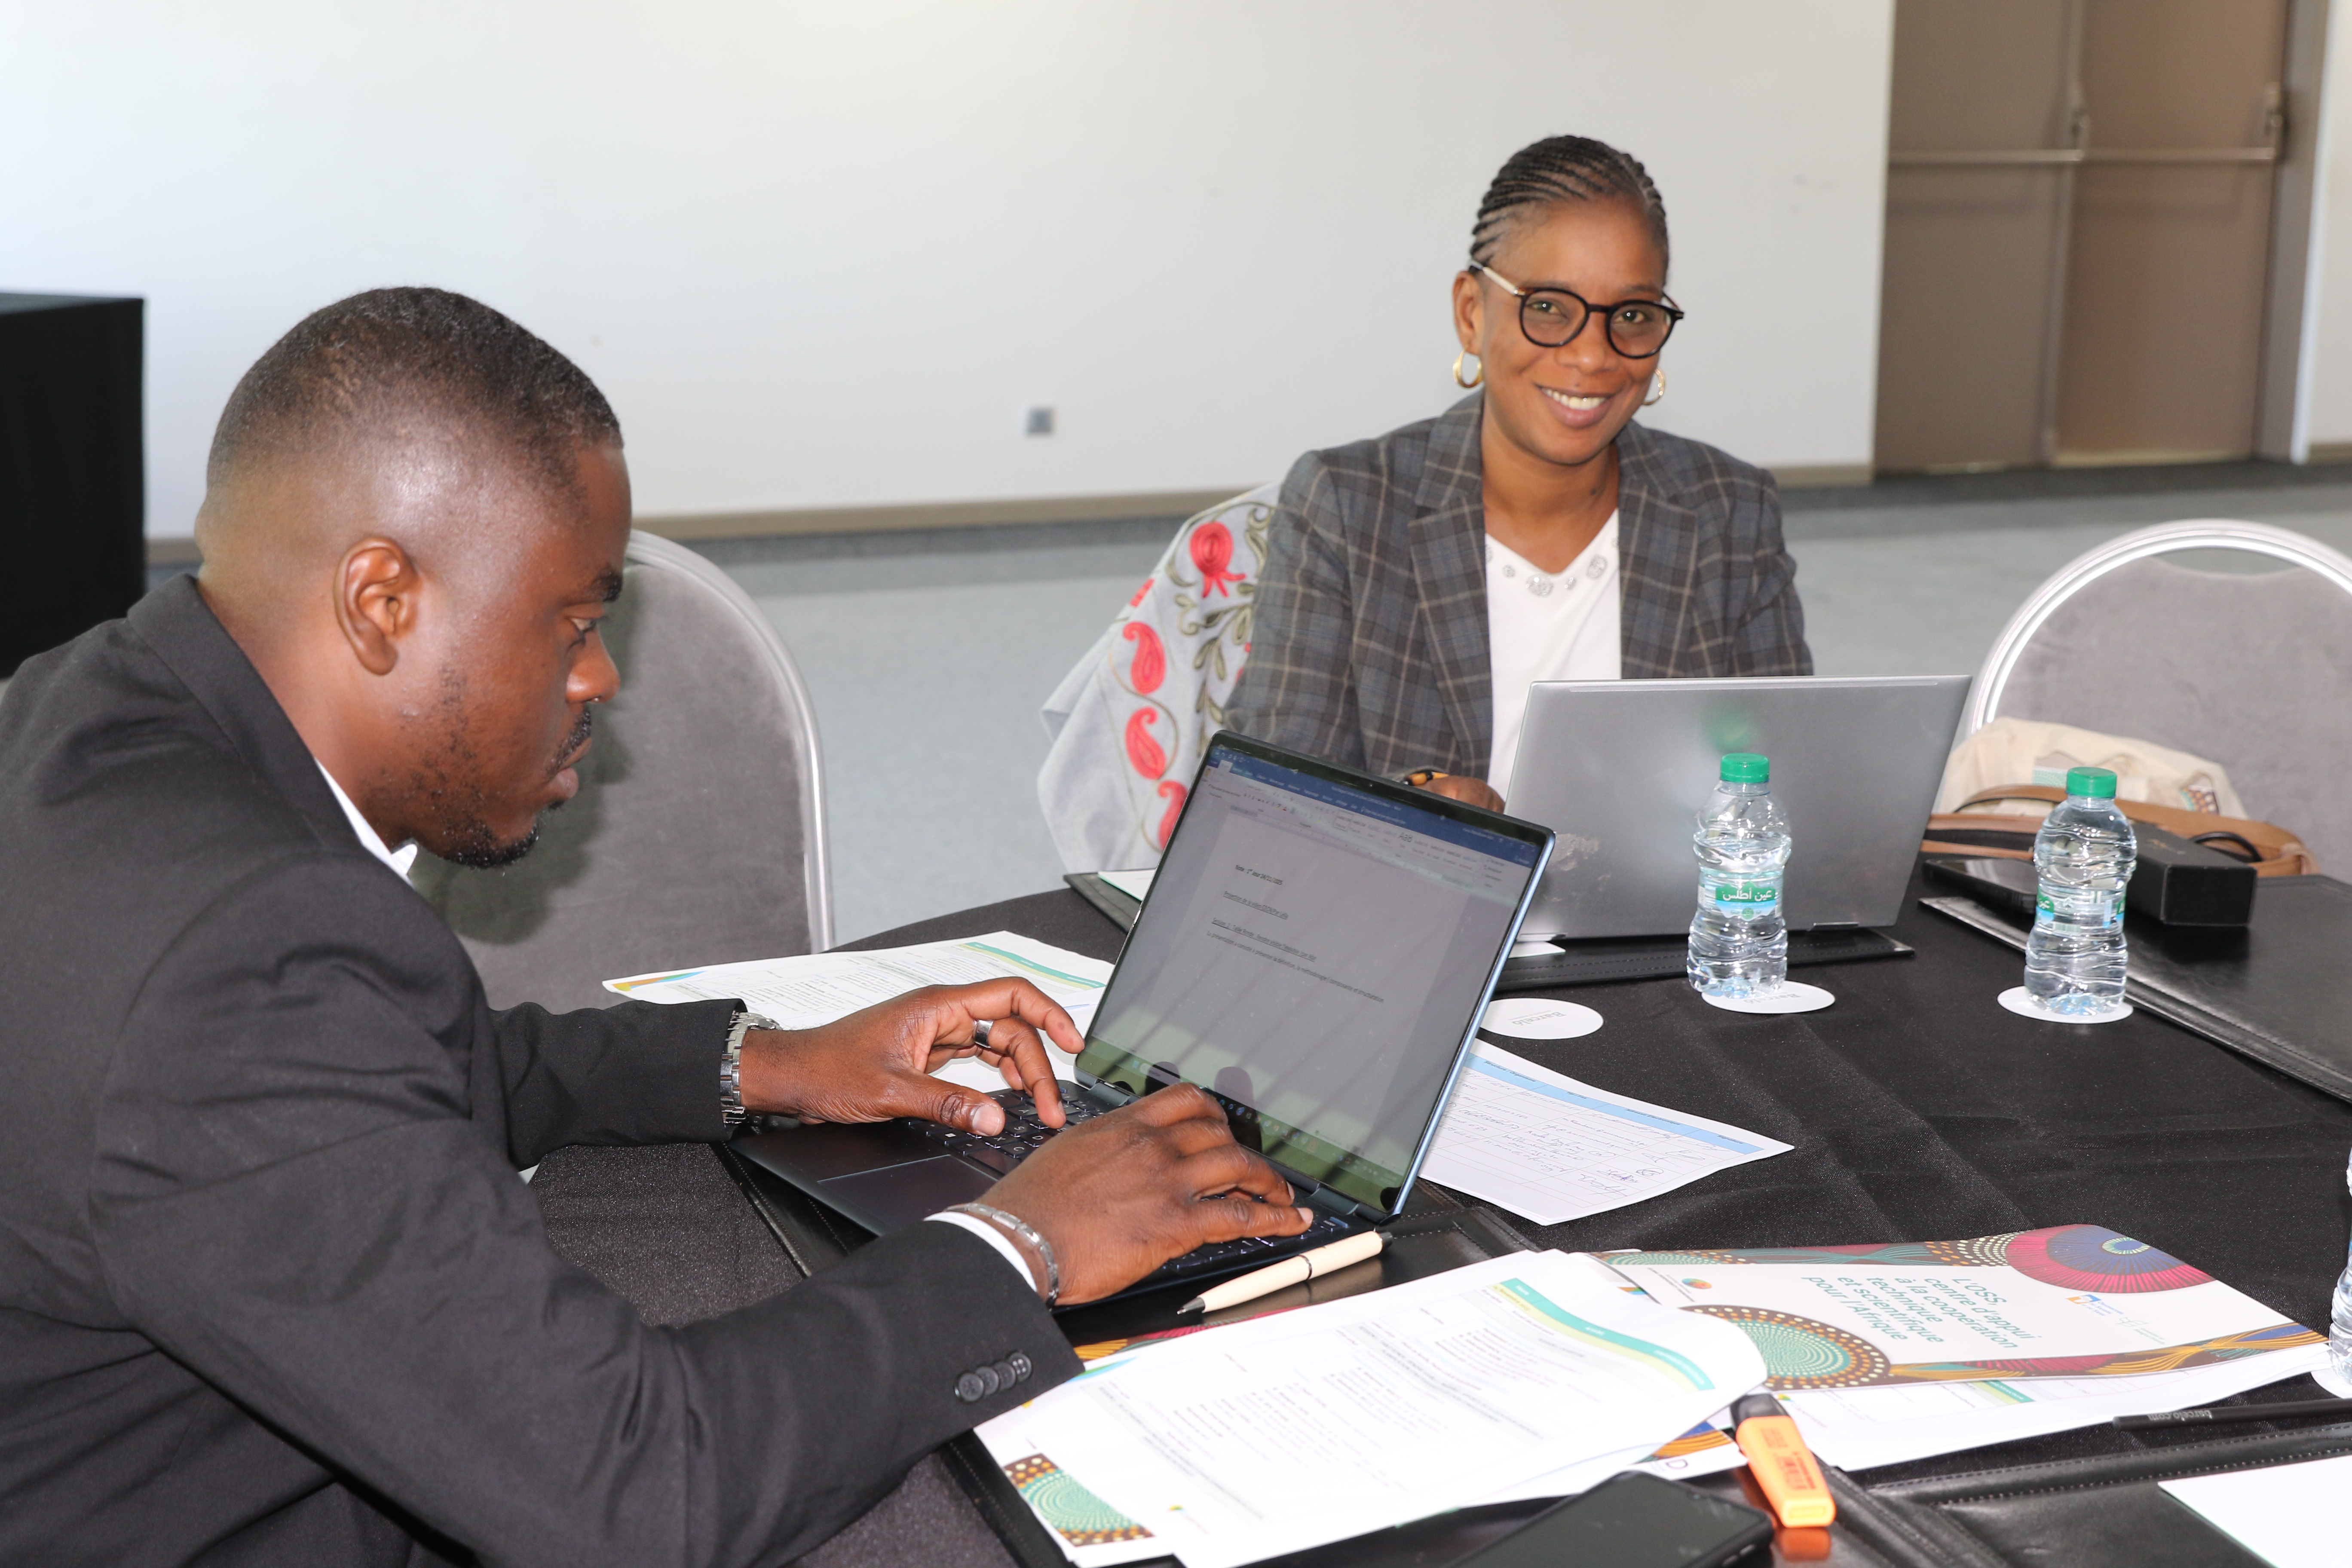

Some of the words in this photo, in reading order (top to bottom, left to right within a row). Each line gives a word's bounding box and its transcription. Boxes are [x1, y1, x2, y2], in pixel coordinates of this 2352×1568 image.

[1722, 887, 1753, 901] أطلس
[1755, 890, 1772, 901] عين
[1512, 1011, 1566, 1026] Barceló
[1484, 1060, 1507, 1072] Structure
[1510, 1070, 1536, 1082] Organisme
[1717, 1135, 1744, 1144] Signature
[1866, 1277, 1943, 1323] technique
[1952, 1278, 2007, 1305] L'OSS,
[1801, 1277, 1849, 1299] pour
[1840, 1301, 1908, 1341] l'Afrique
[1837, 1277, 1863, 1286] et
[1853, 1289, 1944, 1343] scientifique
[1906, 1286, 1928, 1294] la
[1923, 1295, 2018, 1348] coopération
[1923, 1278, 1977, 1307] centre
[1971, 1307, 2043, 1339] d'appui
[2147, 1409, 2213, 1422] barcelo.com
